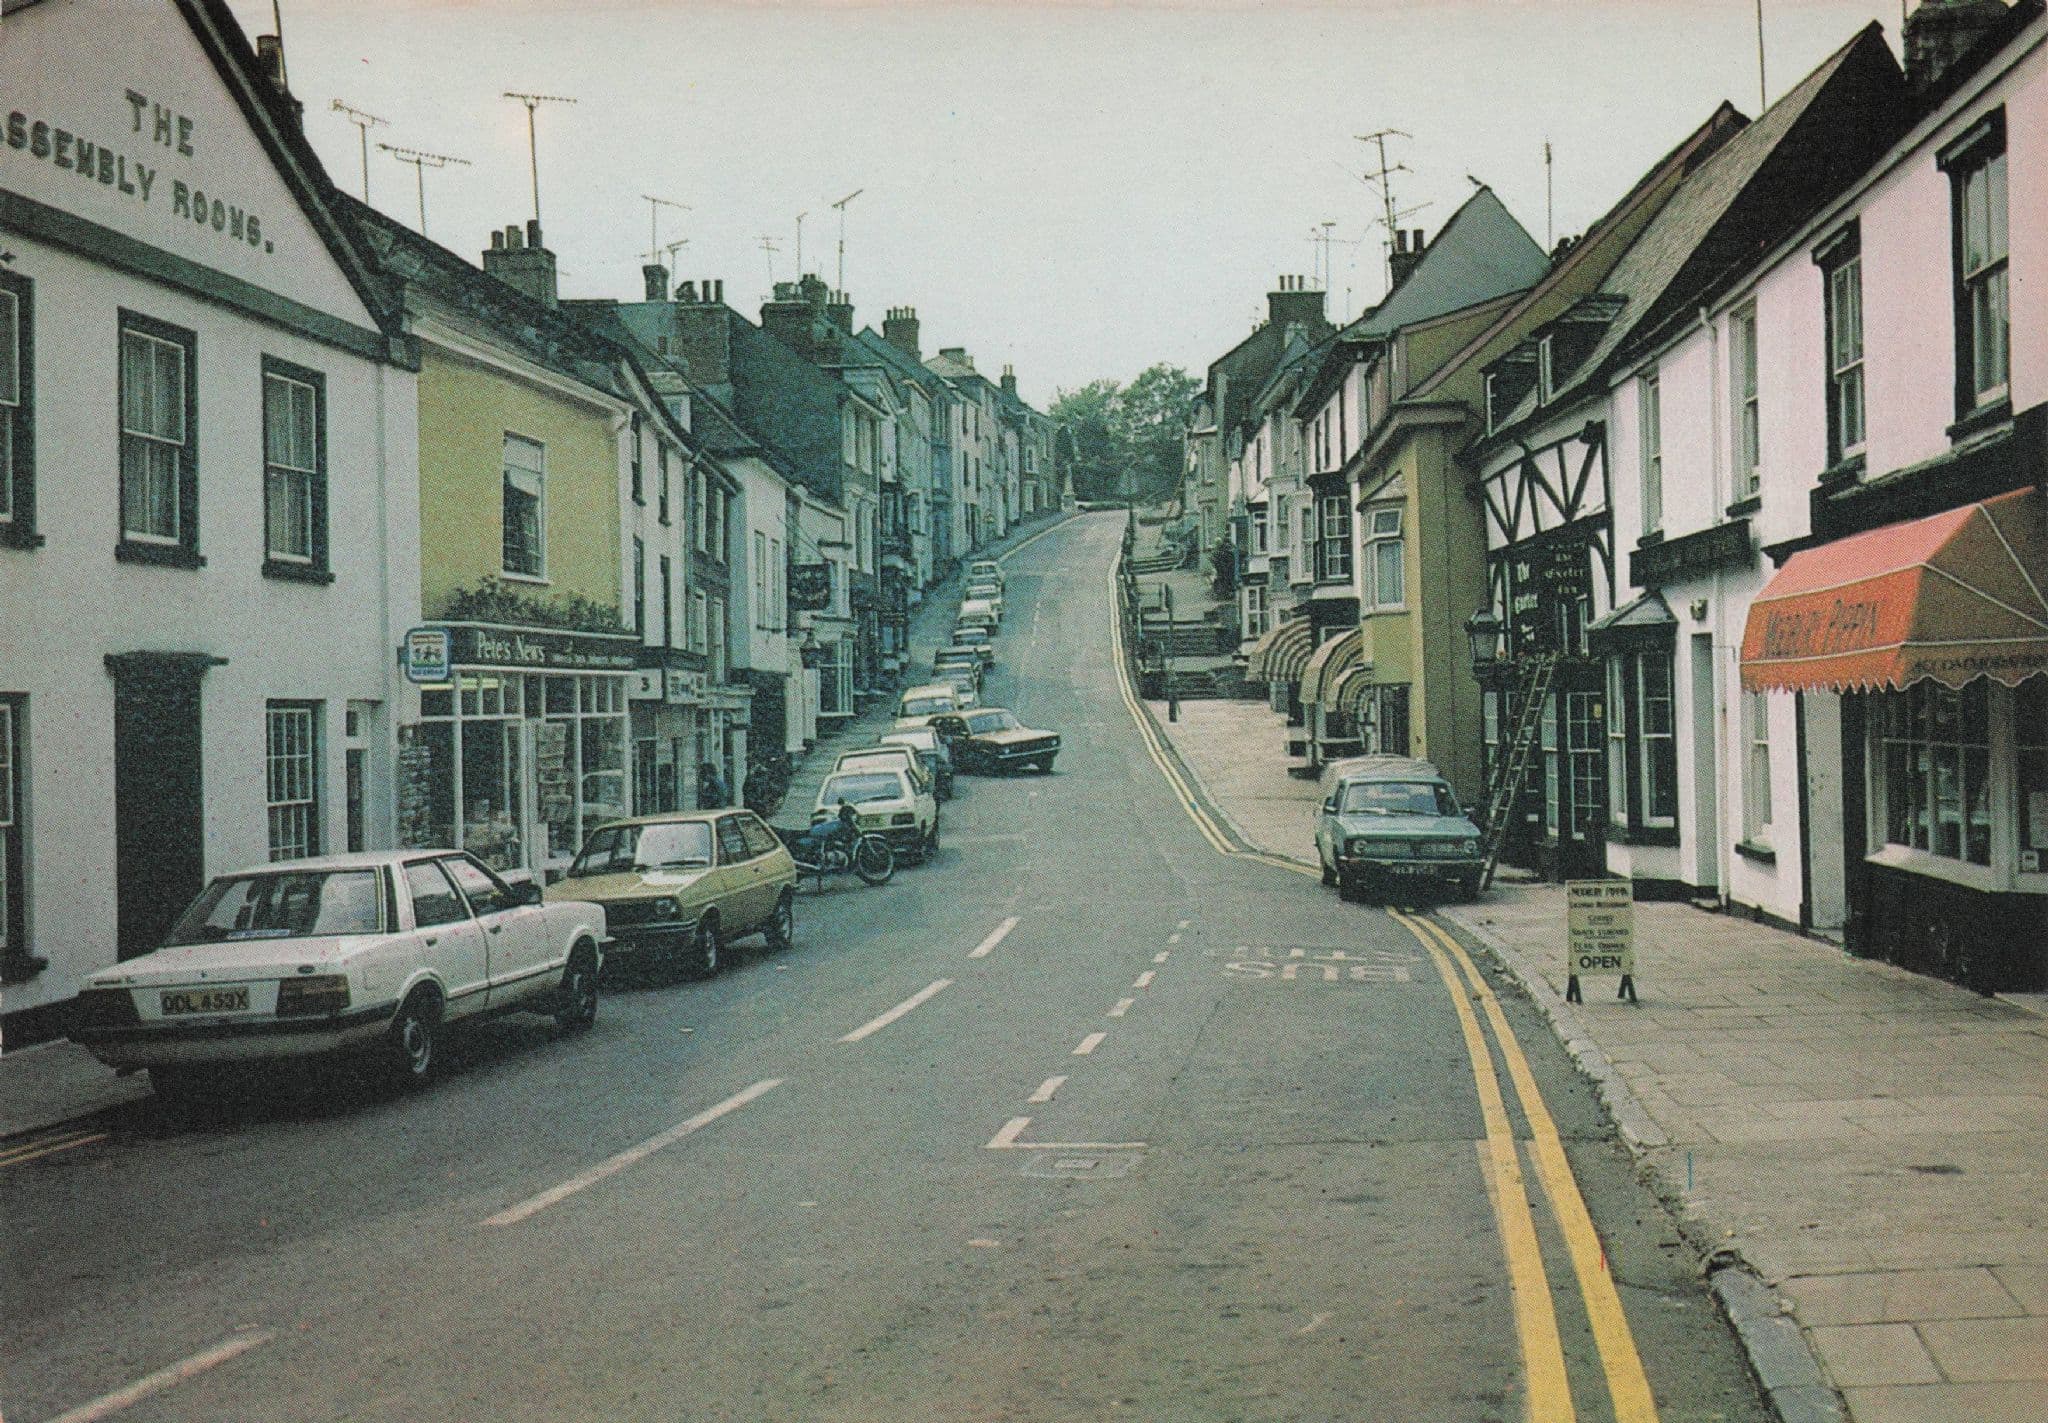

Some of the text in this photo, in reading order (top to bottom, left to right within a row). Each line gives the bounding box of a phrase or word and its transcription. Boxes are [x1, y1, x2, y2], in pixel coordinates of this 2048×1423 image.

[126, 88, 194, 156] THE
[0, 110, 274, 254] SSEMBLY ROOMS.
[1223, 961, 1412, 982] BUS
[1579, 955, 1622, 969] OPEN
